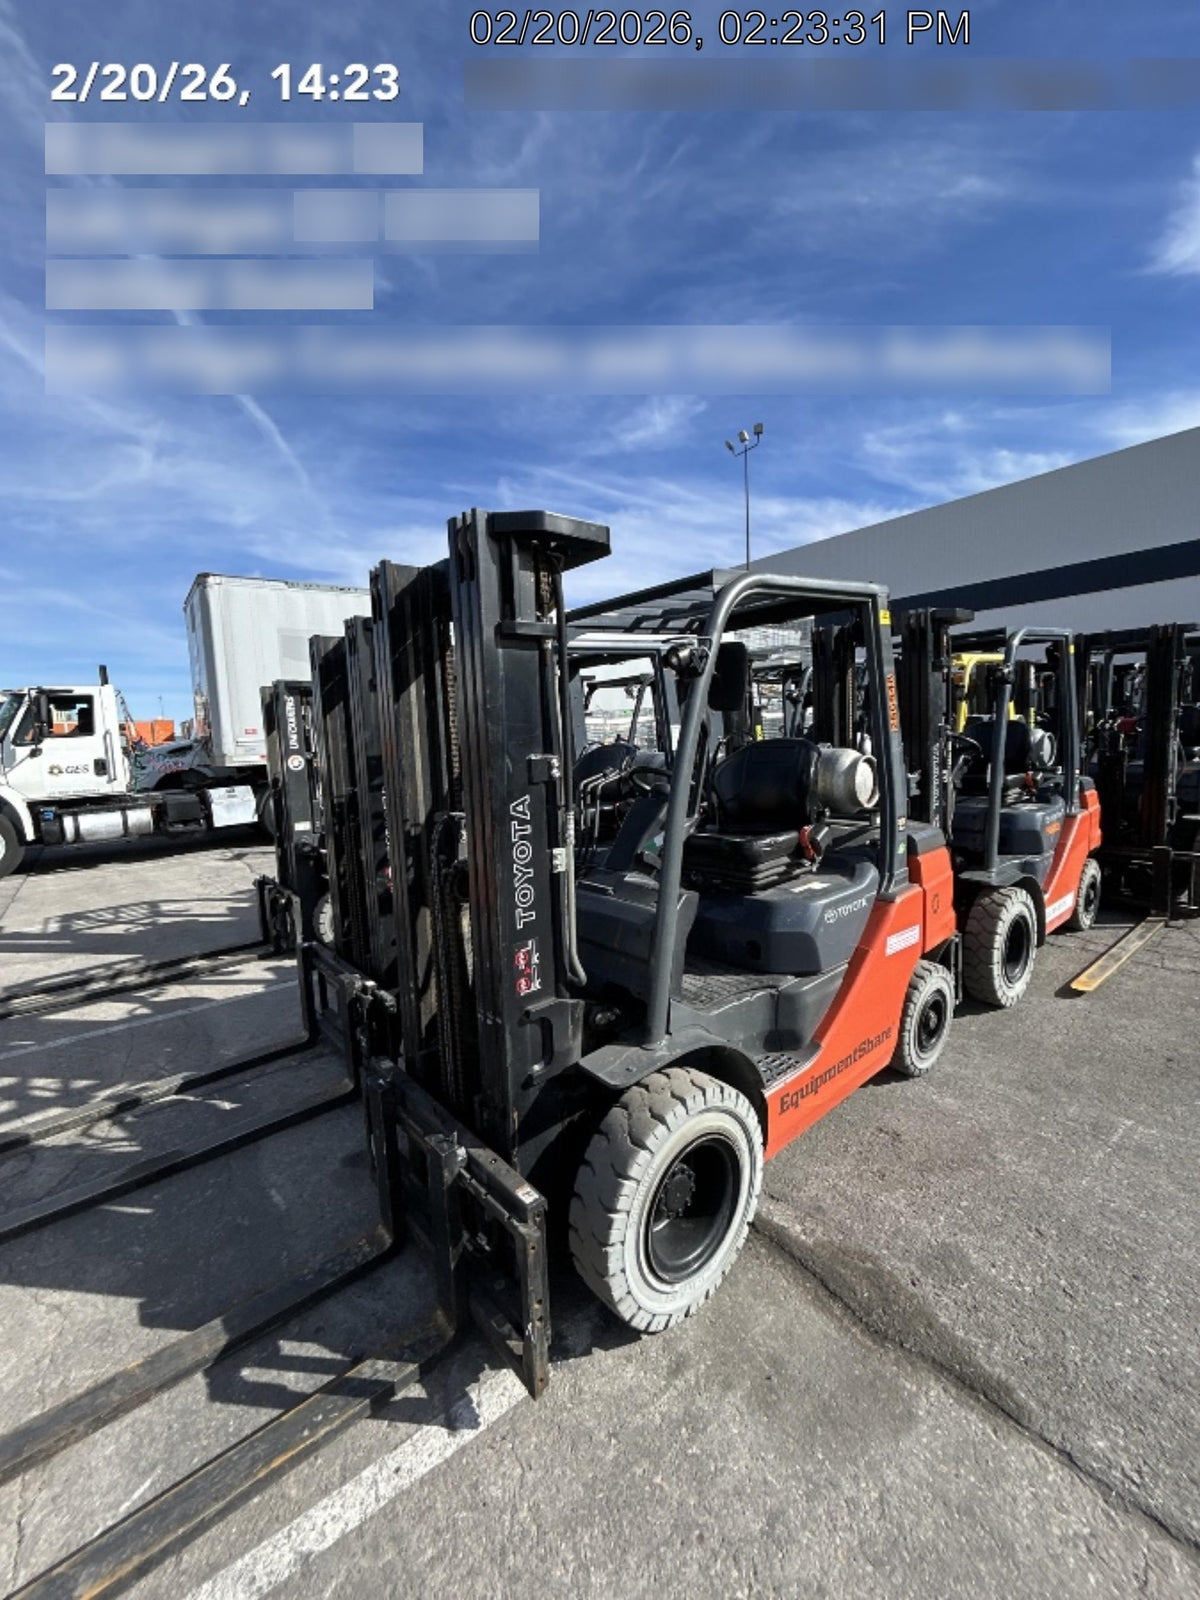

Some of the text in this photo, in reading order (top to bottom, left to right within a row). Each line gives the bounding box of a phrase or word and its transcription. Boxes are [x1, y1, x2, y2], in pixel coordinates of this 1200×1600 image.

[510, 794, 536, 930] TOYOTA
[837, 898, 867, 917] TOYOTA
[778, 1026, 893, 1116] EquipmentShare
